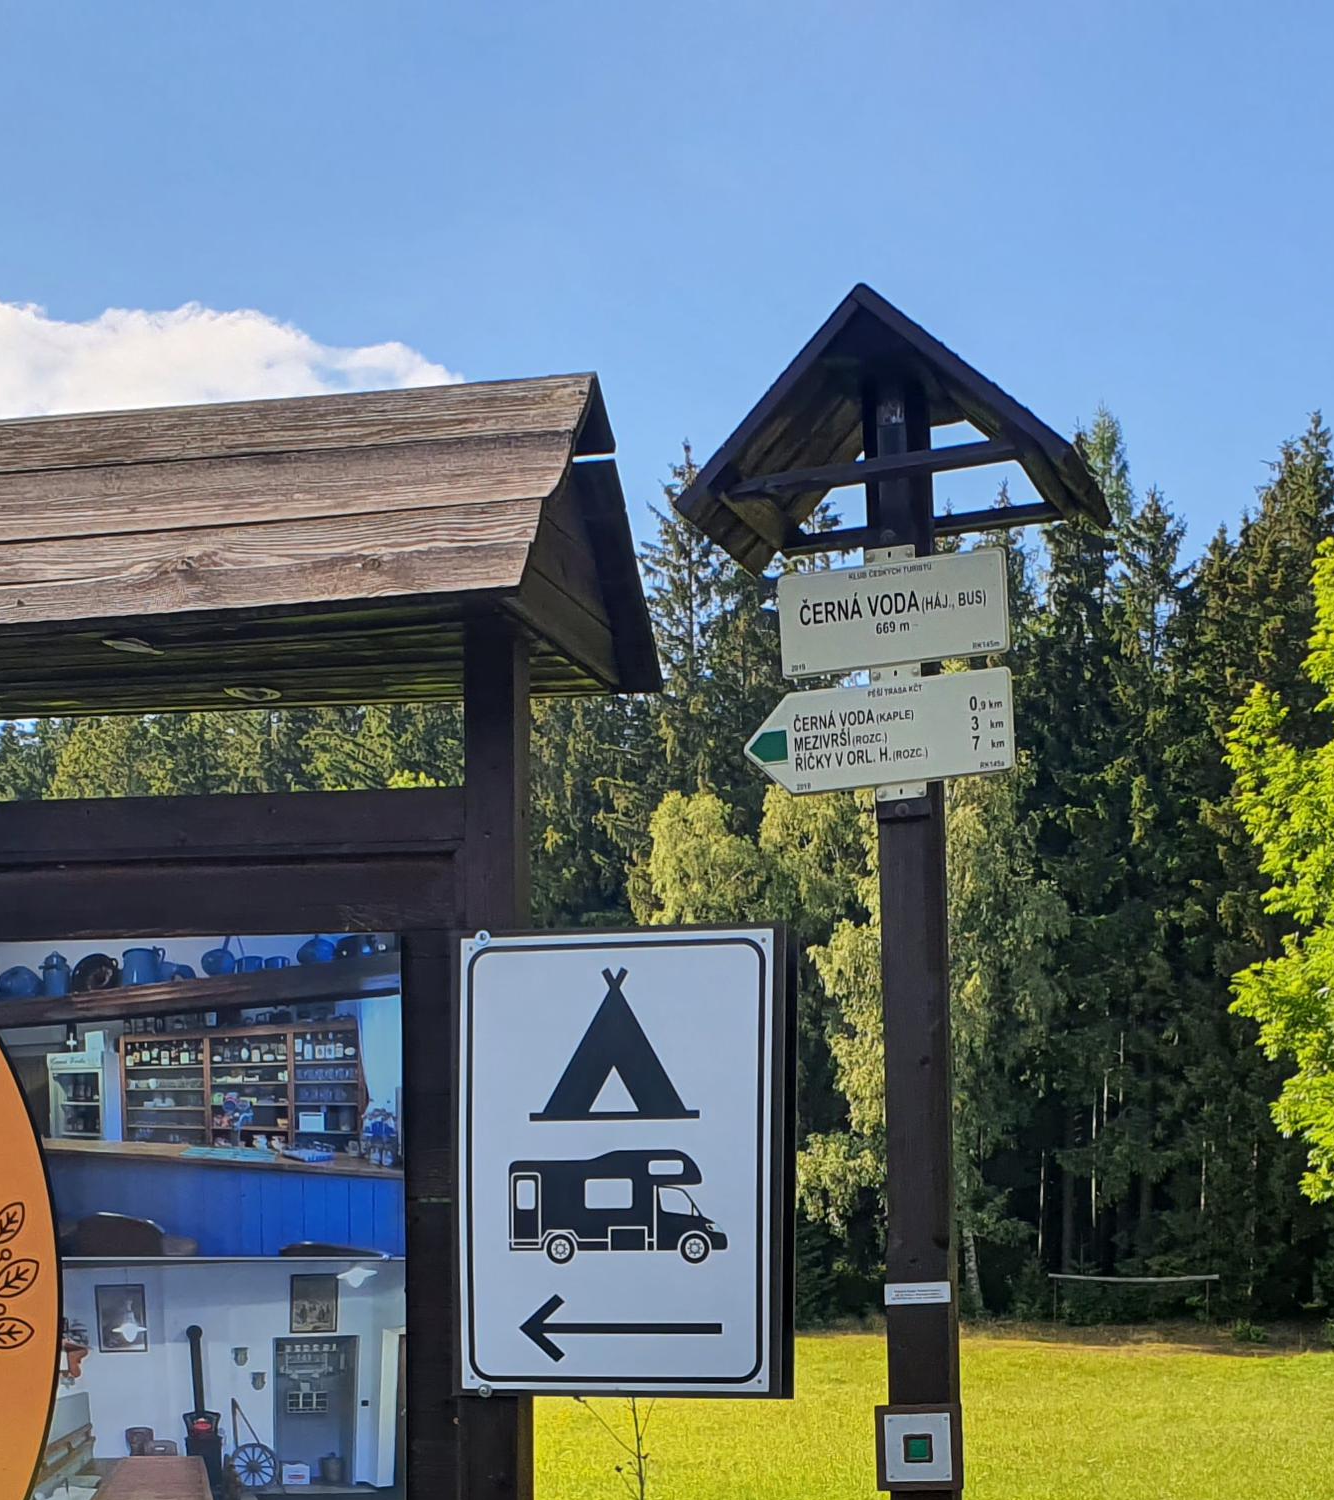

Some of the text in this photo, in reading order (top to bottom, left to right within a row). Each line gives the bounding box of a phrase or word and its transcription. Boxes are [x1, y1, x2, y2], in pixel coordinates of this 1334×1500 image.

[799, 589, 987, 626] ČERNÁ VODA (HÁJ., BUS)
[875, 620, 910, 635] 669 m
[884, 685, 908, 696] TRASA
[908, 682, 923, 692] KČT
[793, 695, 1003, 732] ČERNÁ VODA (KAPLE) 0,9 km
[794, 716, 1004, 752] MEZIVRŠÍ (ROZC.) 3 km
[795, 735, 1005, 772] ŘÍČKY V ORL. H. (ROZC.) 7 km
